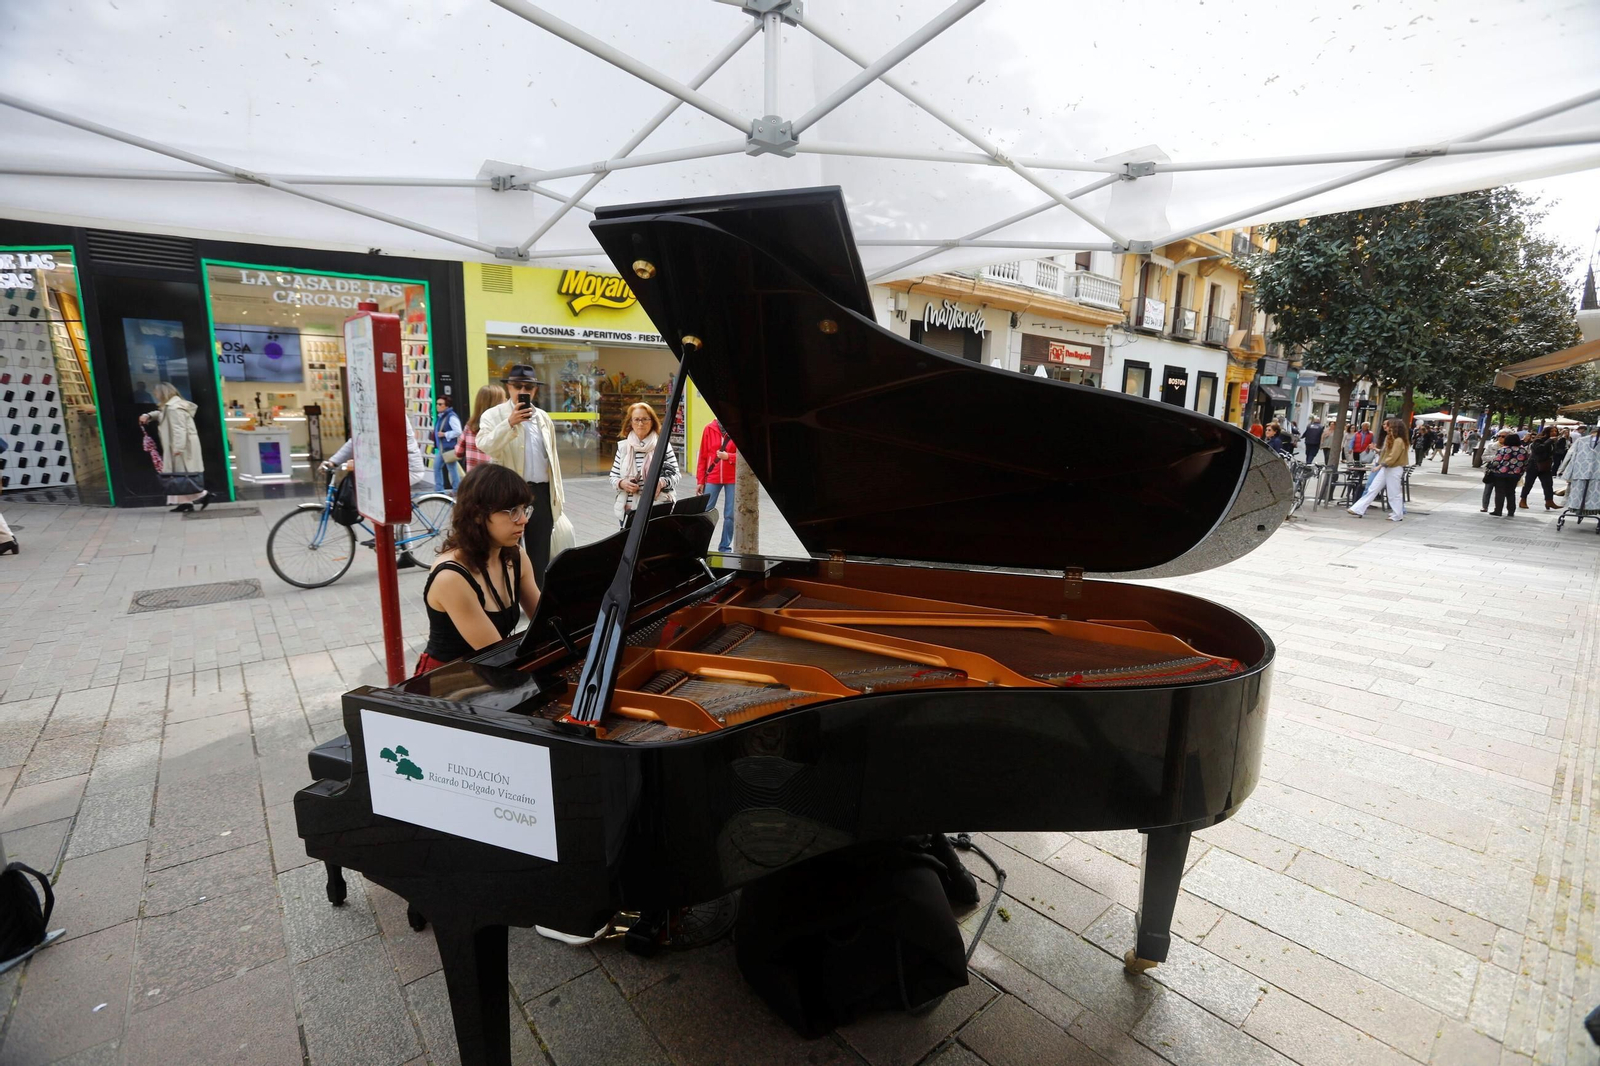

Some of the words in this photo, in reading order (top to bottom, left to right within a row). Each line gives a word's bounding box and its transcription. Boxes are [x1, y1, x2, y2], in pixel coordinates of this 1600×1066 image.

[17, 254, 56, 270] LAS
[239, 270, 271, 286] LA
[277, 275, 333, 291] CASA
[335, 279, 362, 294] DE
[368, 281, 403, 297] LAS
[559, 269, 637, 304] Moyan
[521, 325, 575, 337] GOLOSINAS
[583, 330, 632, 341] APERITIVOS
[1168, 377, 1186, 386] BOSTON
[447, 763, 510, 786] FUNDACIÓN
[428, 772, 460, 787] Ricardo
[461, 780, 496, 796] Delgado
[498, 787, 536, 805] Vizcaíno
[493, 807, 537, 827] COVAP
